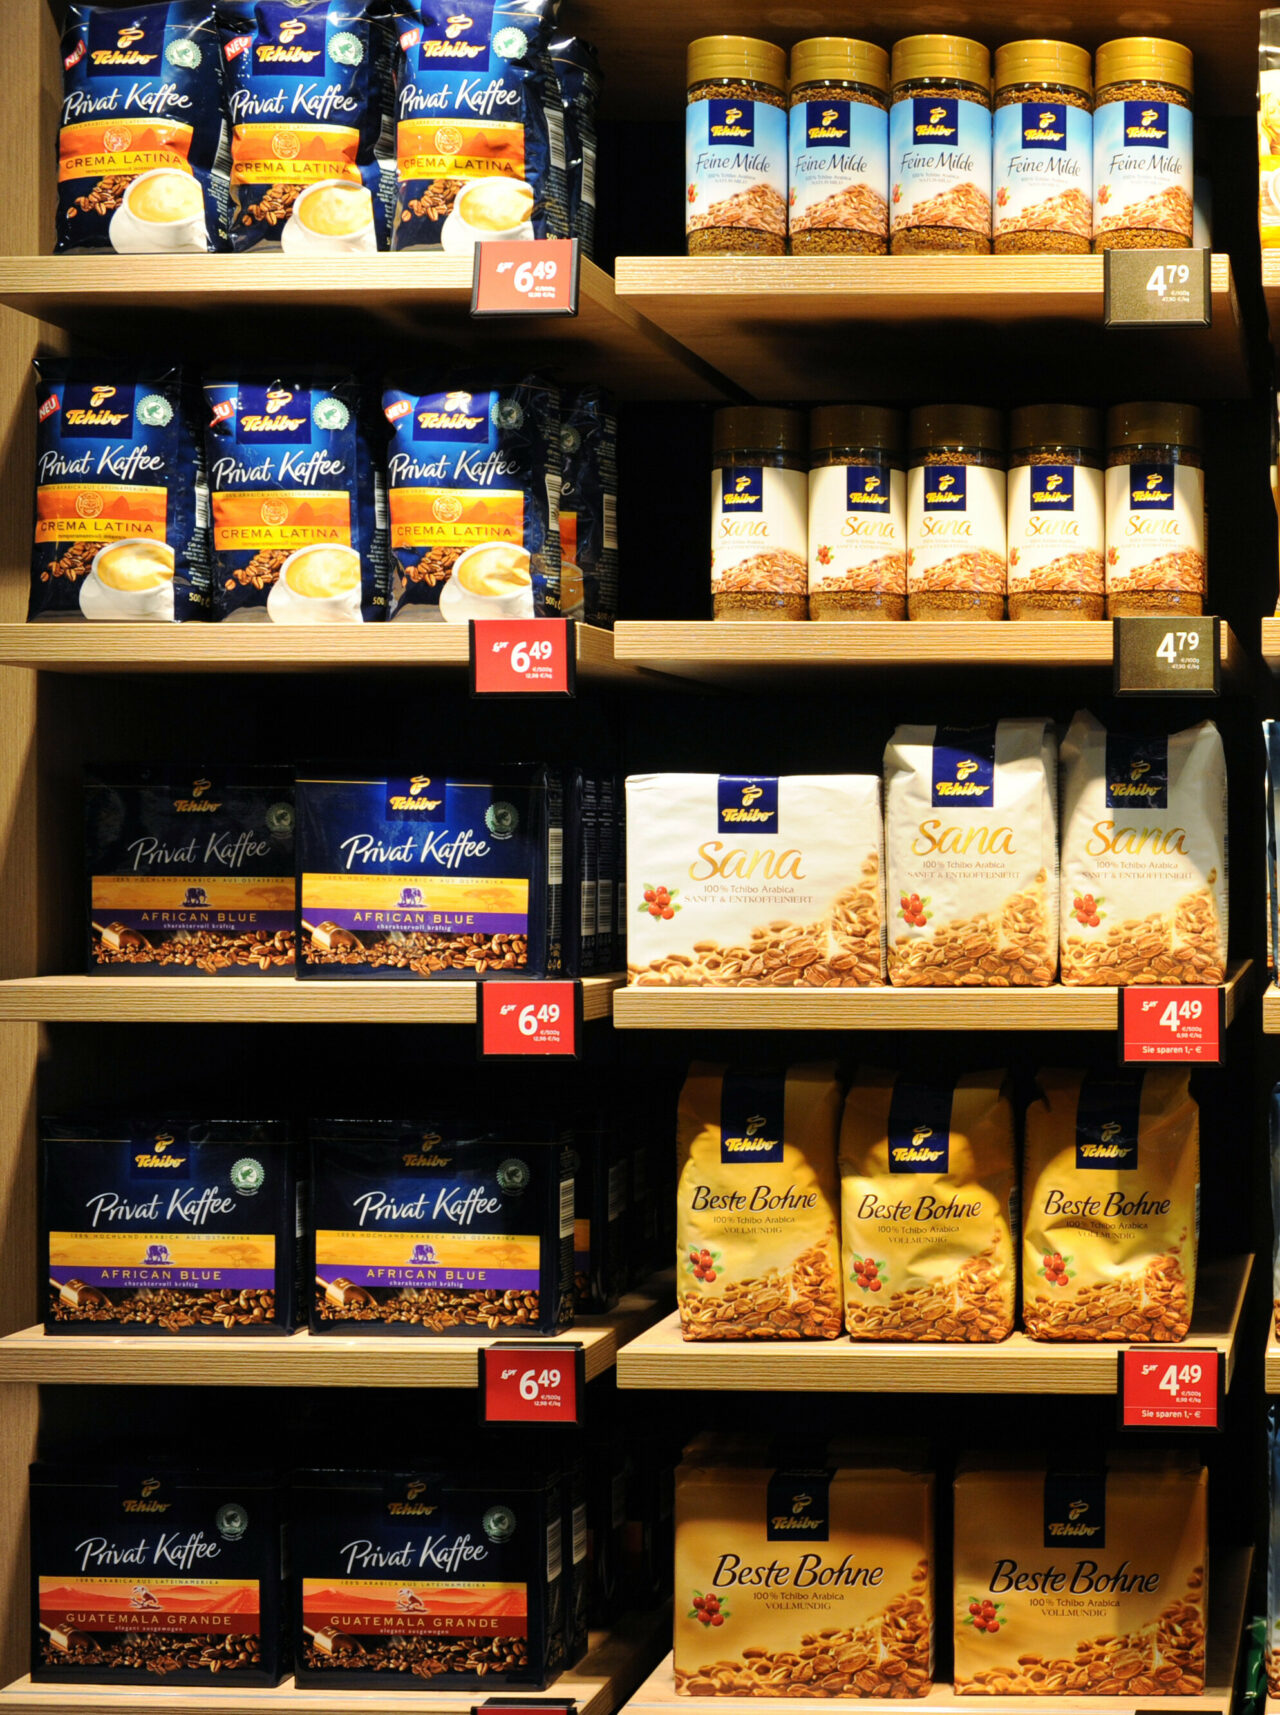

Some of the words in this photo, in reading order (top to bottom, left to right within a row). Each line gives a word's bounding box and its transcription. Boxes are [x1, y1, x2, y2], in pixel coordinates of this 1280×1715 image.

[65, 44, 85, 67] NEU
[91, 50, 158, 65] Tchibo
[64, 88, 122, 124] Privat
[124, 82, 192, 114] Kaffee
[400, 84, 453, 119] Privat
[455, 79, 521, 115] Kaffee
[915, 125, 955, 137] Tchibo
[65, 155, 115, 170] CREMA
[123, 152, 183, 166] LATINA
[404, 158, 446, 170] CREMA
[454, 159, 514, 173] LATINA
[696, 153, 729, 176] Feine
[730, 151, 770, 173] Milde
[900, 151, 934, 172] Feine
[933, 151, 974, 172] Milde
[39, 397, 58, 419] NEU
[66, 410, 129, 425] Tchibo
[39, 450, 95, 483] Privat
[97, 445, 164, 479] Kaffee
[388, 453, 452, 487] Privat
[454, 450, 520, 486] Kaffee
[849, 492, 888, 504] Tchibo
[41, 521, 88, 532] CREMA
[94, 520, 154, 533] LATINA
[841, 516, 895, 538] Sana
[1110, 783, 1161, 798] Tchibo
[389, 797, 442, 811] Tchibo
[721, 808, 774, 822] Tchibo
[911, 820, 1017, 856] Sana
[1085, 820, 1191, 856] Sana
[340, 834, 418, 869] Privat
[420, 829, 490, 869] Kaffee
[688, 841, 807, 882] Sana
[353, 911, 427, 924] AFRICAN
[433, 914, 475, 925] BLUE
[1142, 1046, 1154, 1055] Sie
[1156, 1047, 1183, 1057] sparen
[725, 1138, 778, 1152] Tchibo
[135, 1155, 186, 1168] Tchibo
[86, 1193, 163, 1227] Privat
[166, 1186, 237, 1226] Kaffee
[353, 1191, 430, 1226] Privat
[432, 1186, 501, 1225] Kaffee
[691, 1186, 748, 1211] Beste
[750, 1185, 817, 1212] Bohne
[858, 1194, 912, 1221] Beste
[914, 1194, 982, 1221] Bohne
[1044, 1190, 1101, 1216] Beste
[1103, 1191, 1171, 1217] Bohne
[101, 1269, 172, 1280] AFRICAN
[180, 1271, 222, 1280] BLUE
[367, 1269, 437, 1280] AFRICAN
[445, 1270, 487, 1281] BLUE
[388, 1502, 438, 1516] Tchibo
[1049, 1523, 1099, 1536] Tchibo
[75, 1537, 150, 1571] Privat
[153, 1531, 221, 1570] Kaffee
[341, 1540, 416, 1573] Privat
[419, 1534, 487, 1572] Kaffee
[712, 1554, 790, 1588] Beste
[793, 1554, 884, 1588] Bohne
[989, 1559, 1066, 1595] Beste
[1069, 1561, 1160, 1595] Bohne
[765, 1602, 831, 1610] VOLLMUNDIG
[781, 1592, 809, 1600] Tchibo
[812, 1592, 844, 1601] Arabica
[67, 1613, 159, 1624] GUATEMALA
[168, 1615, 232, 1626] GRANDE
[331, 1616, 425, 1627] GUATEMALA
[433, 1617, 499, 1628] GRANDE
